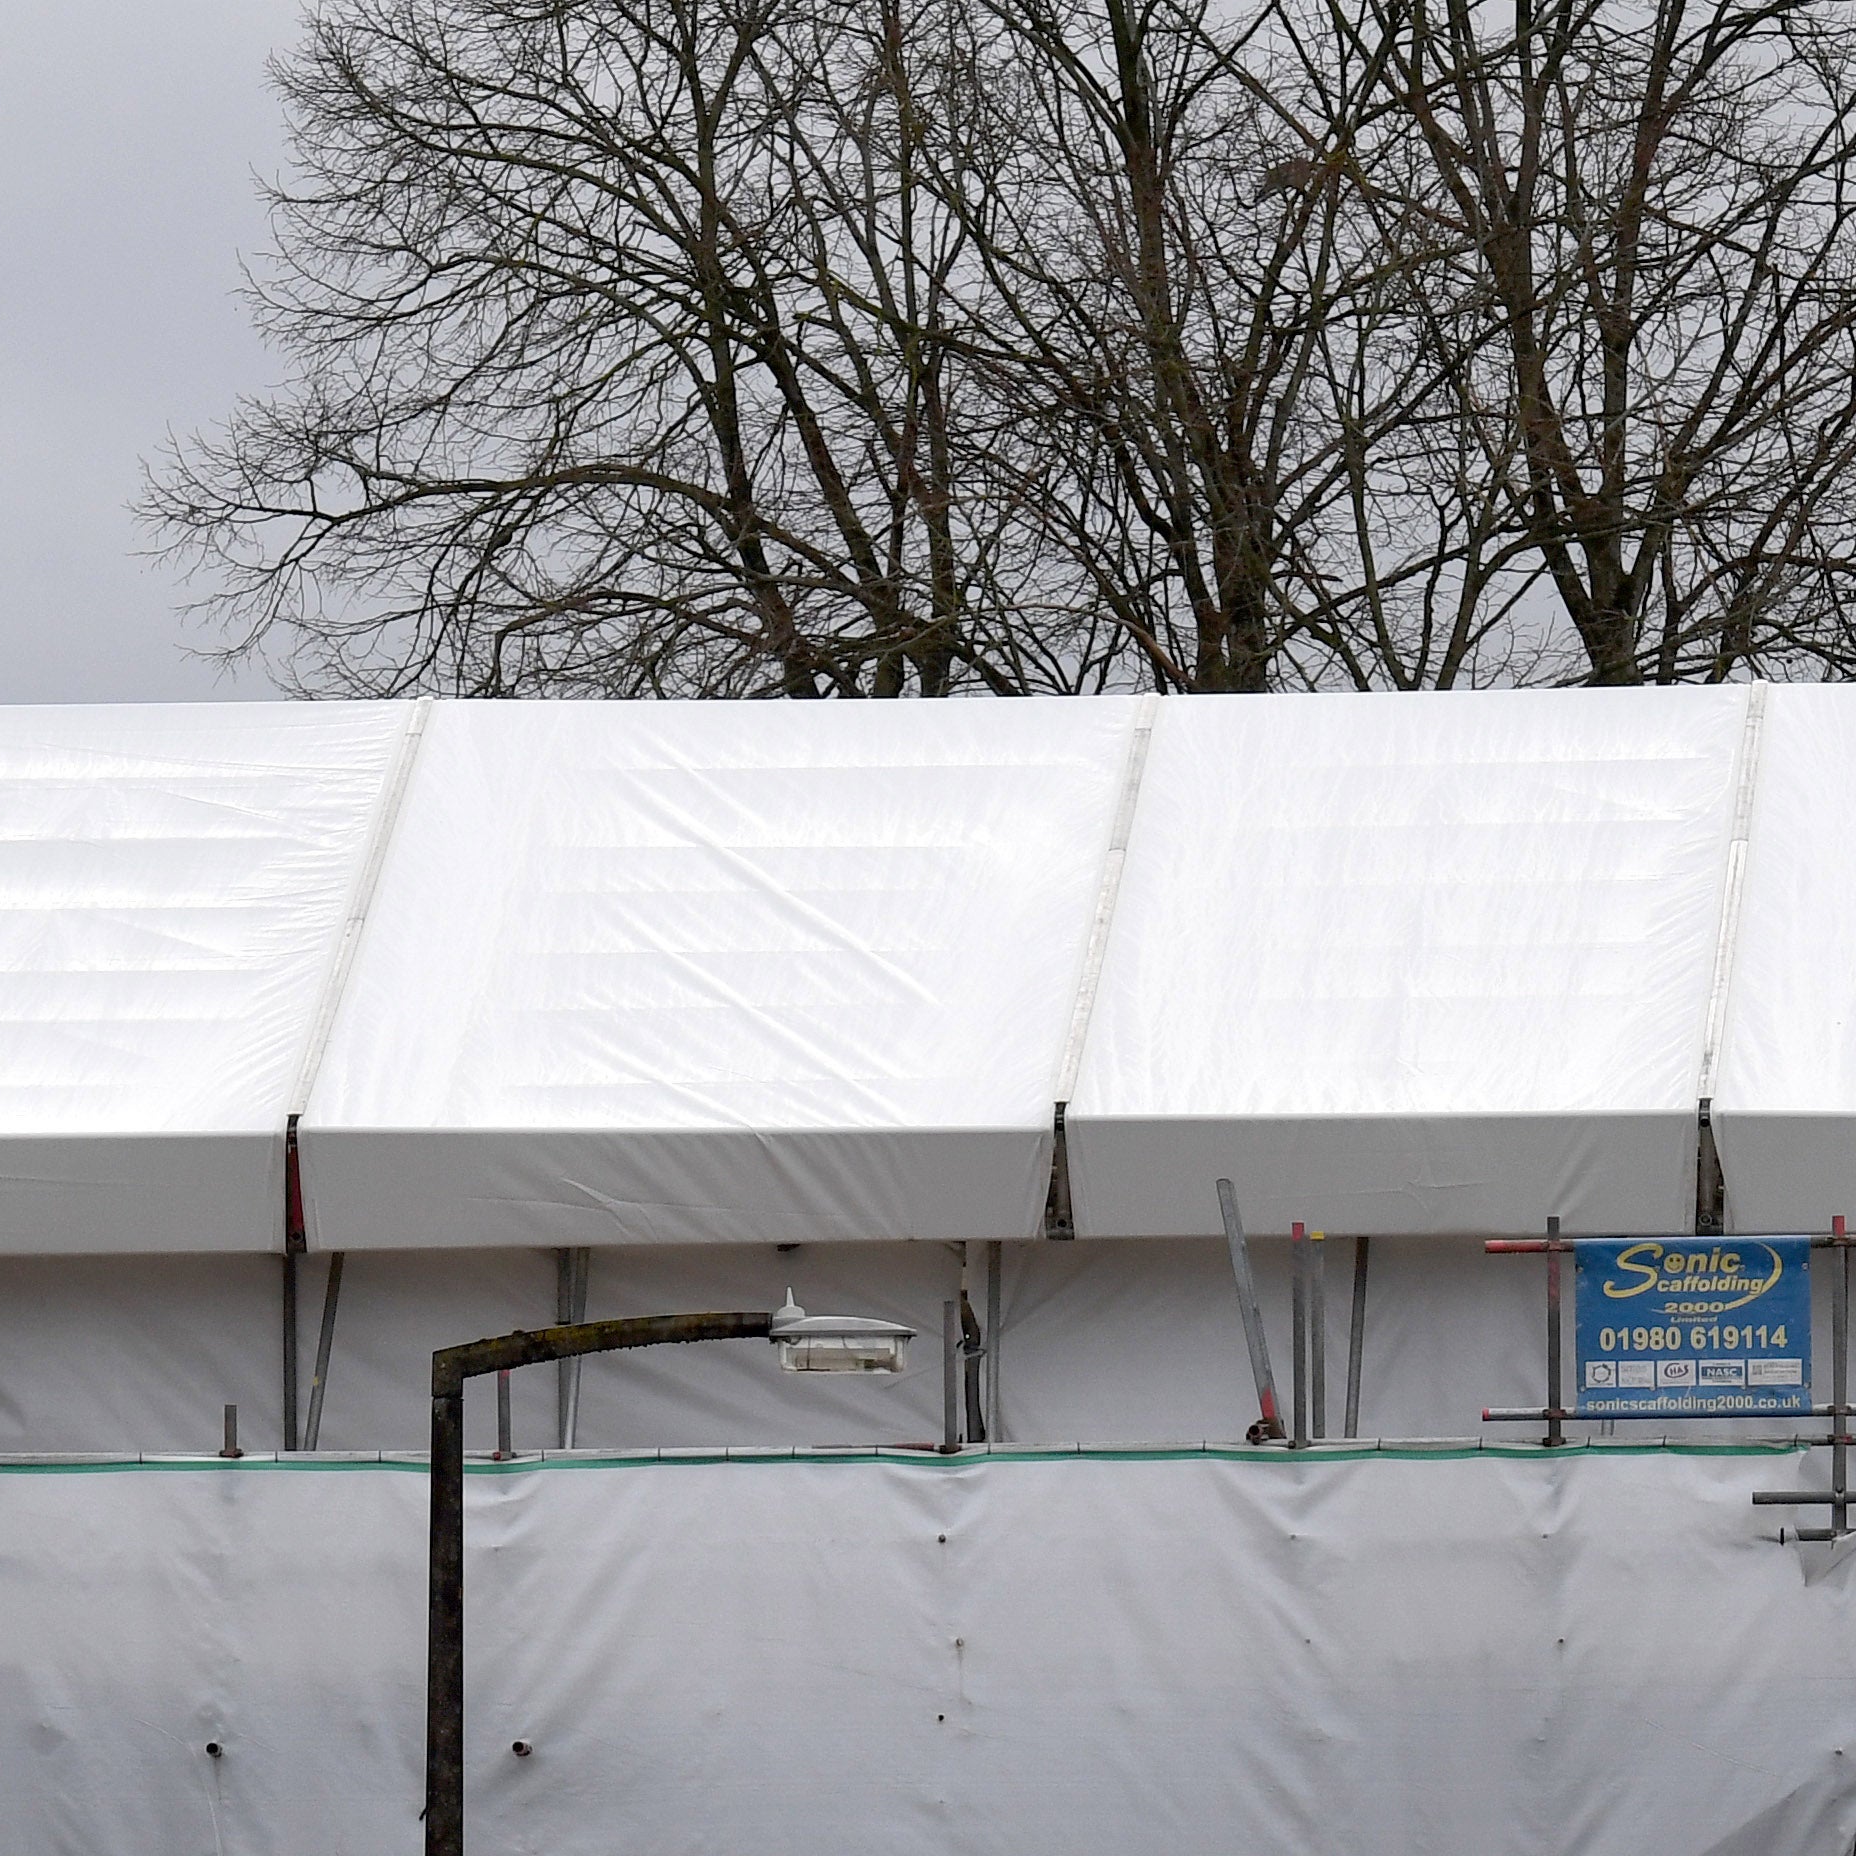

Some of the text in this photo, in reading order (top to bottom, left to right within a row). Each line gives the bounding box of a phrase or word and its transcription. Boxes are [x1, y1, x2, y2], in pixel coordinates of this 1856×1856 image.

[1603, 1242, 1741, 1299] Sonic
[1664, 1302, 1726, 1314] 2000
[1670, 1315, 1719, 1323] Limited
[1599, 1325, 1788, 1351] 01980 619114
[1706, 1367, 1738, 1377] NASC
[1586, 1395, 1802, 1412] sonicscaffolding2000.co.uk
